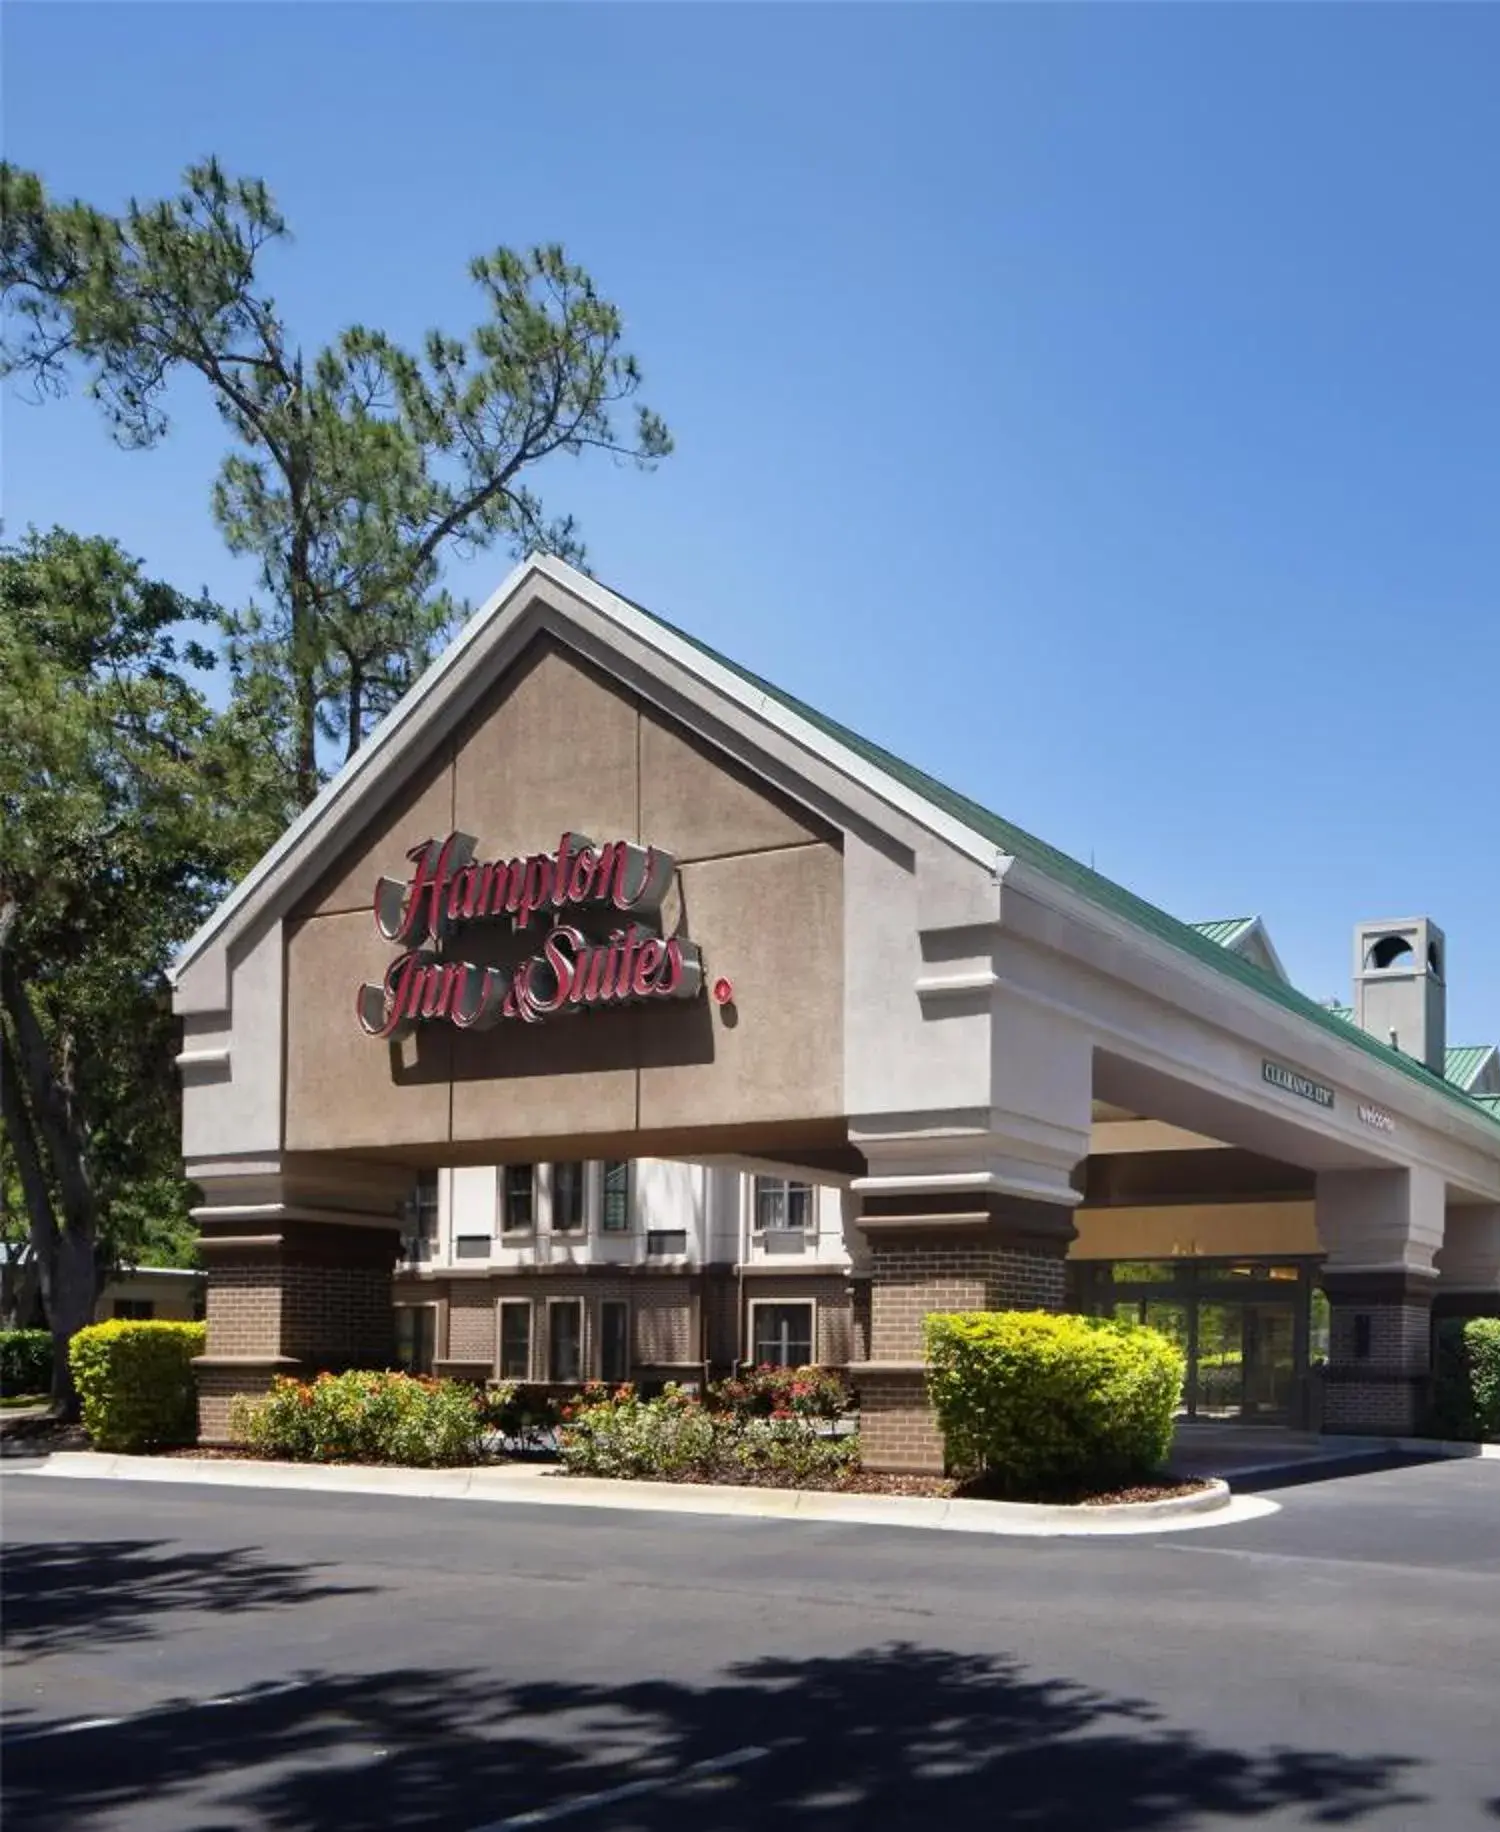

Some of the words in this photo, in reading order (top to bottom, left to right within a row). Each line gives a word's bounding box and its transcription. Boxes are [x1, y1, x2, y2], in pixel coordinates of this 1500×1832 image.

[374, 831, 662, 942] Hampton
[357, 949, 498, 1038] Inn
[526, 921, 690, 1012] Suites
